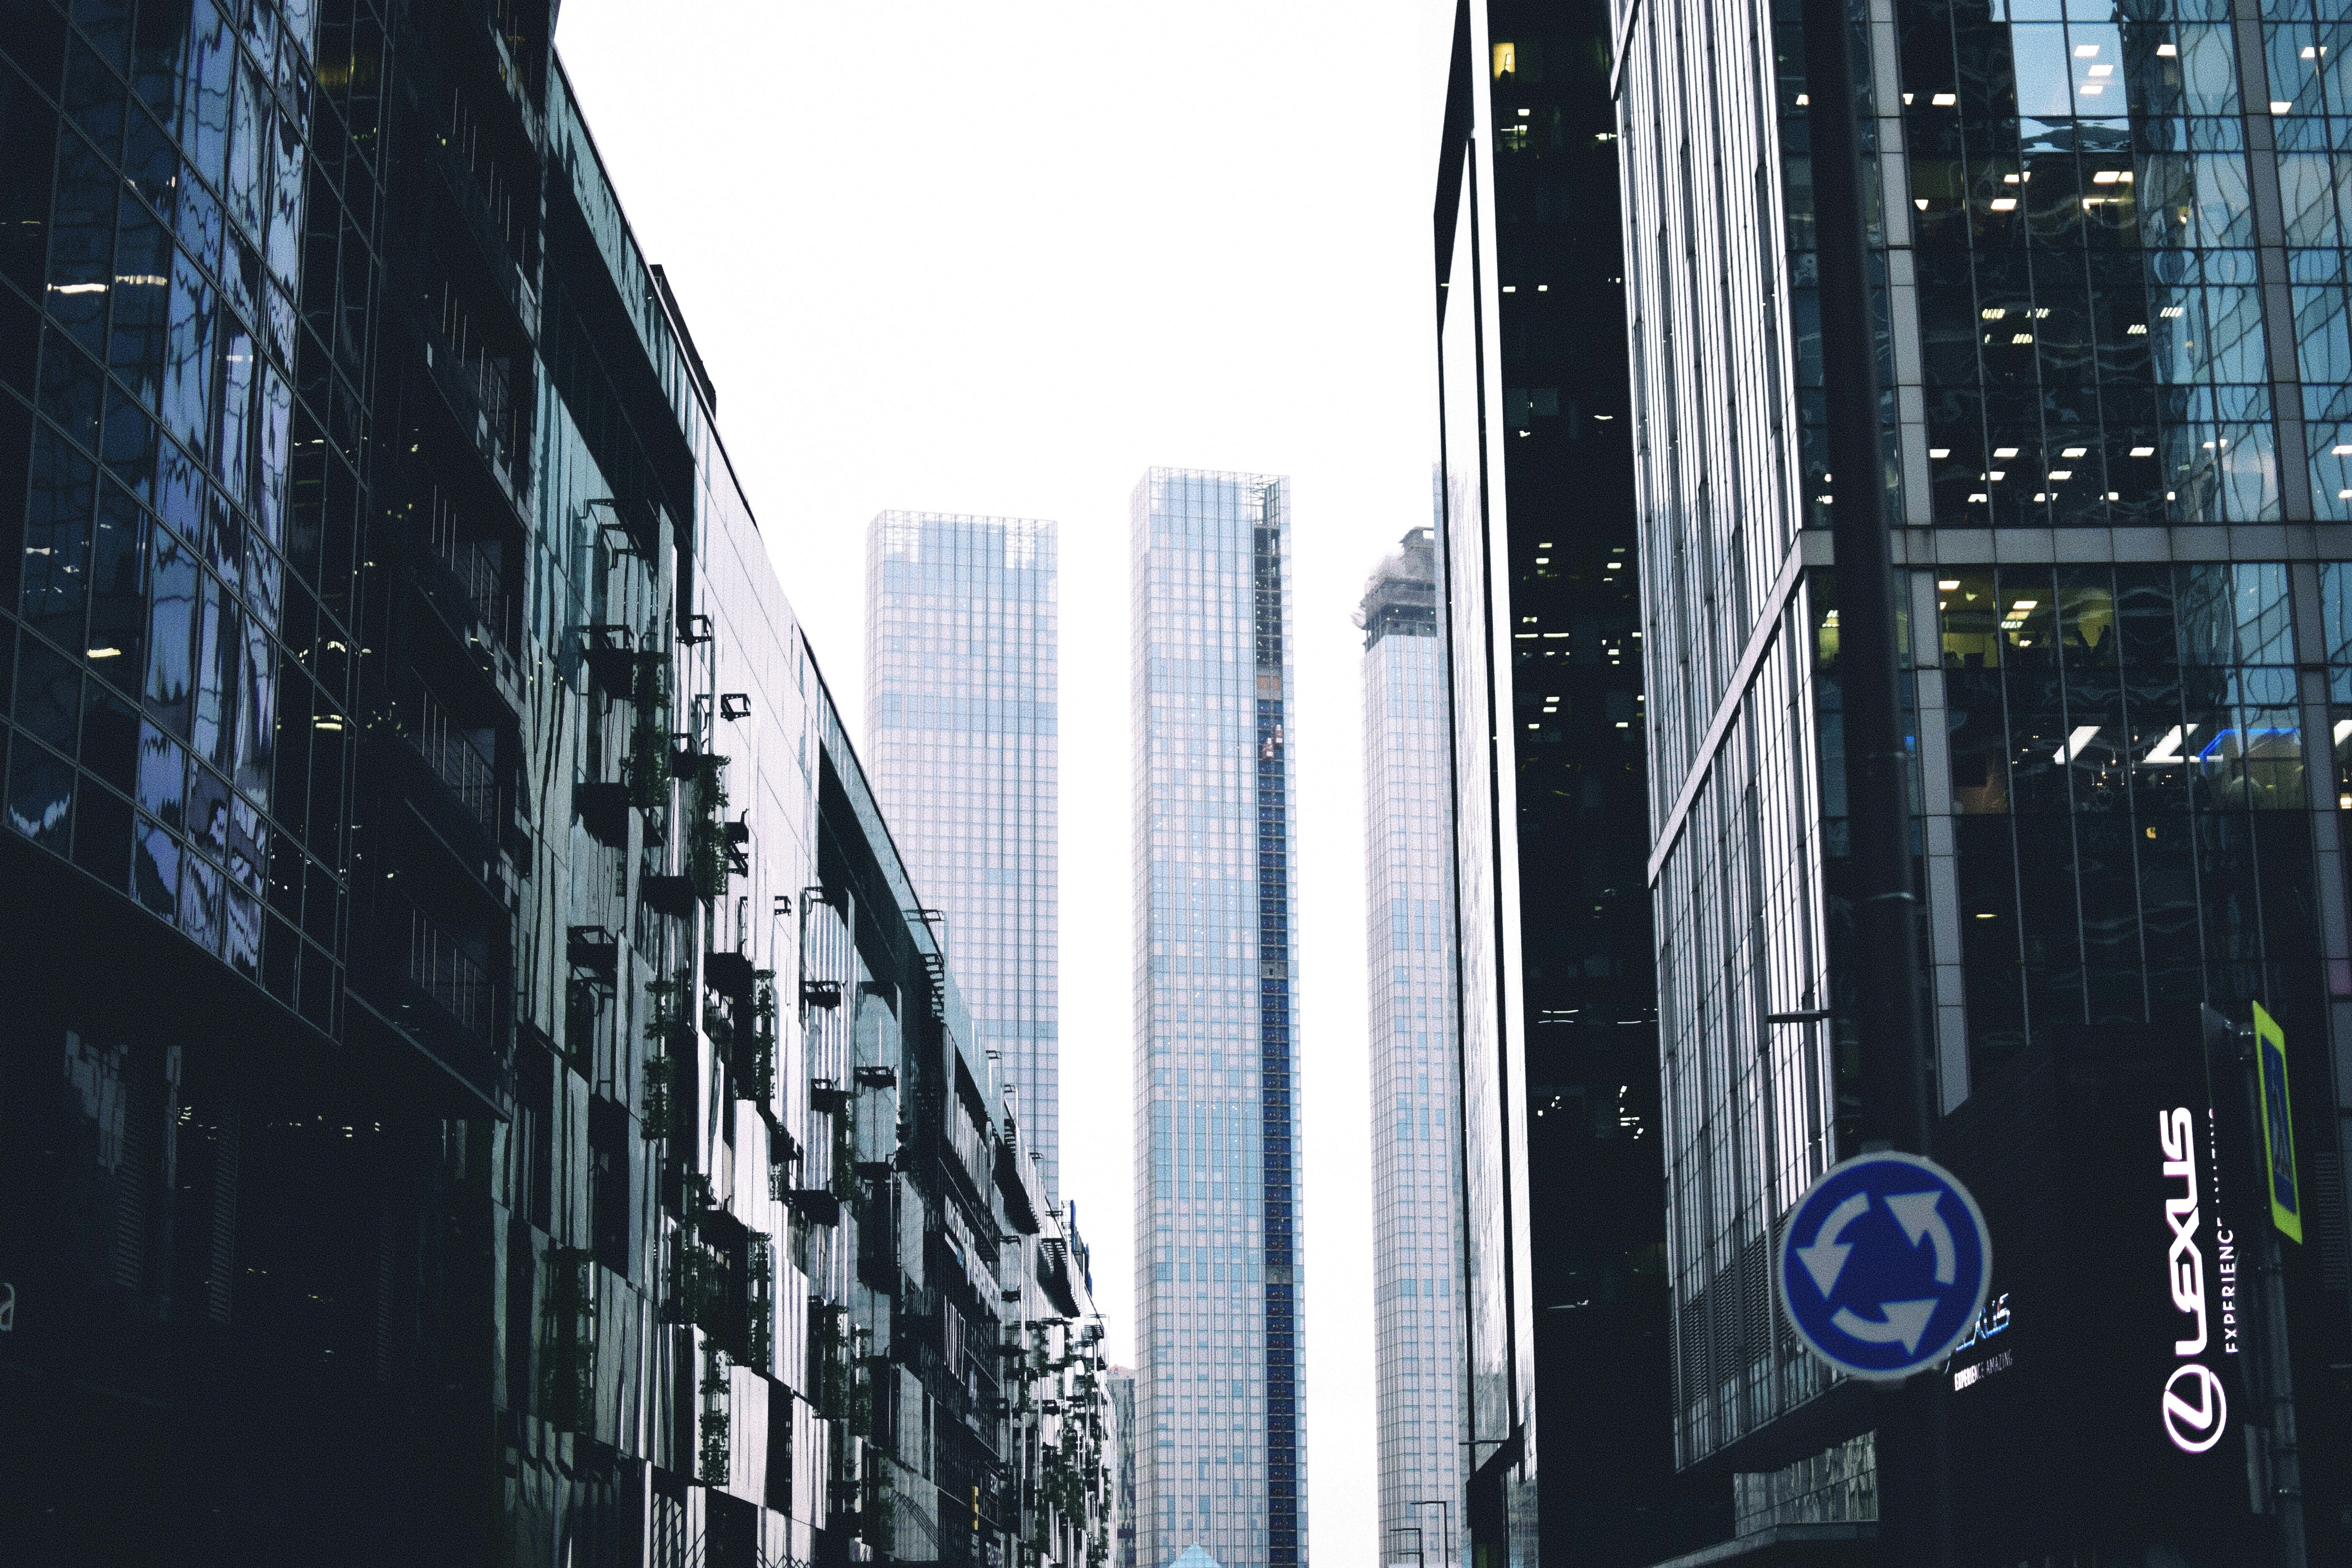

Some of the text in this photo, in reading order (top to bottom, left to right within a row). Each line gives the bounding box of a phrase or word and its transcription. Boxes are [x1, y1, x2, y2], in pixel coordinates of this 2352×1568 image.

[2159, 1107, 2208, 1357] LEXUS
[1954, 1349, 2013, 1391] EXPERIENCE AMAZING
